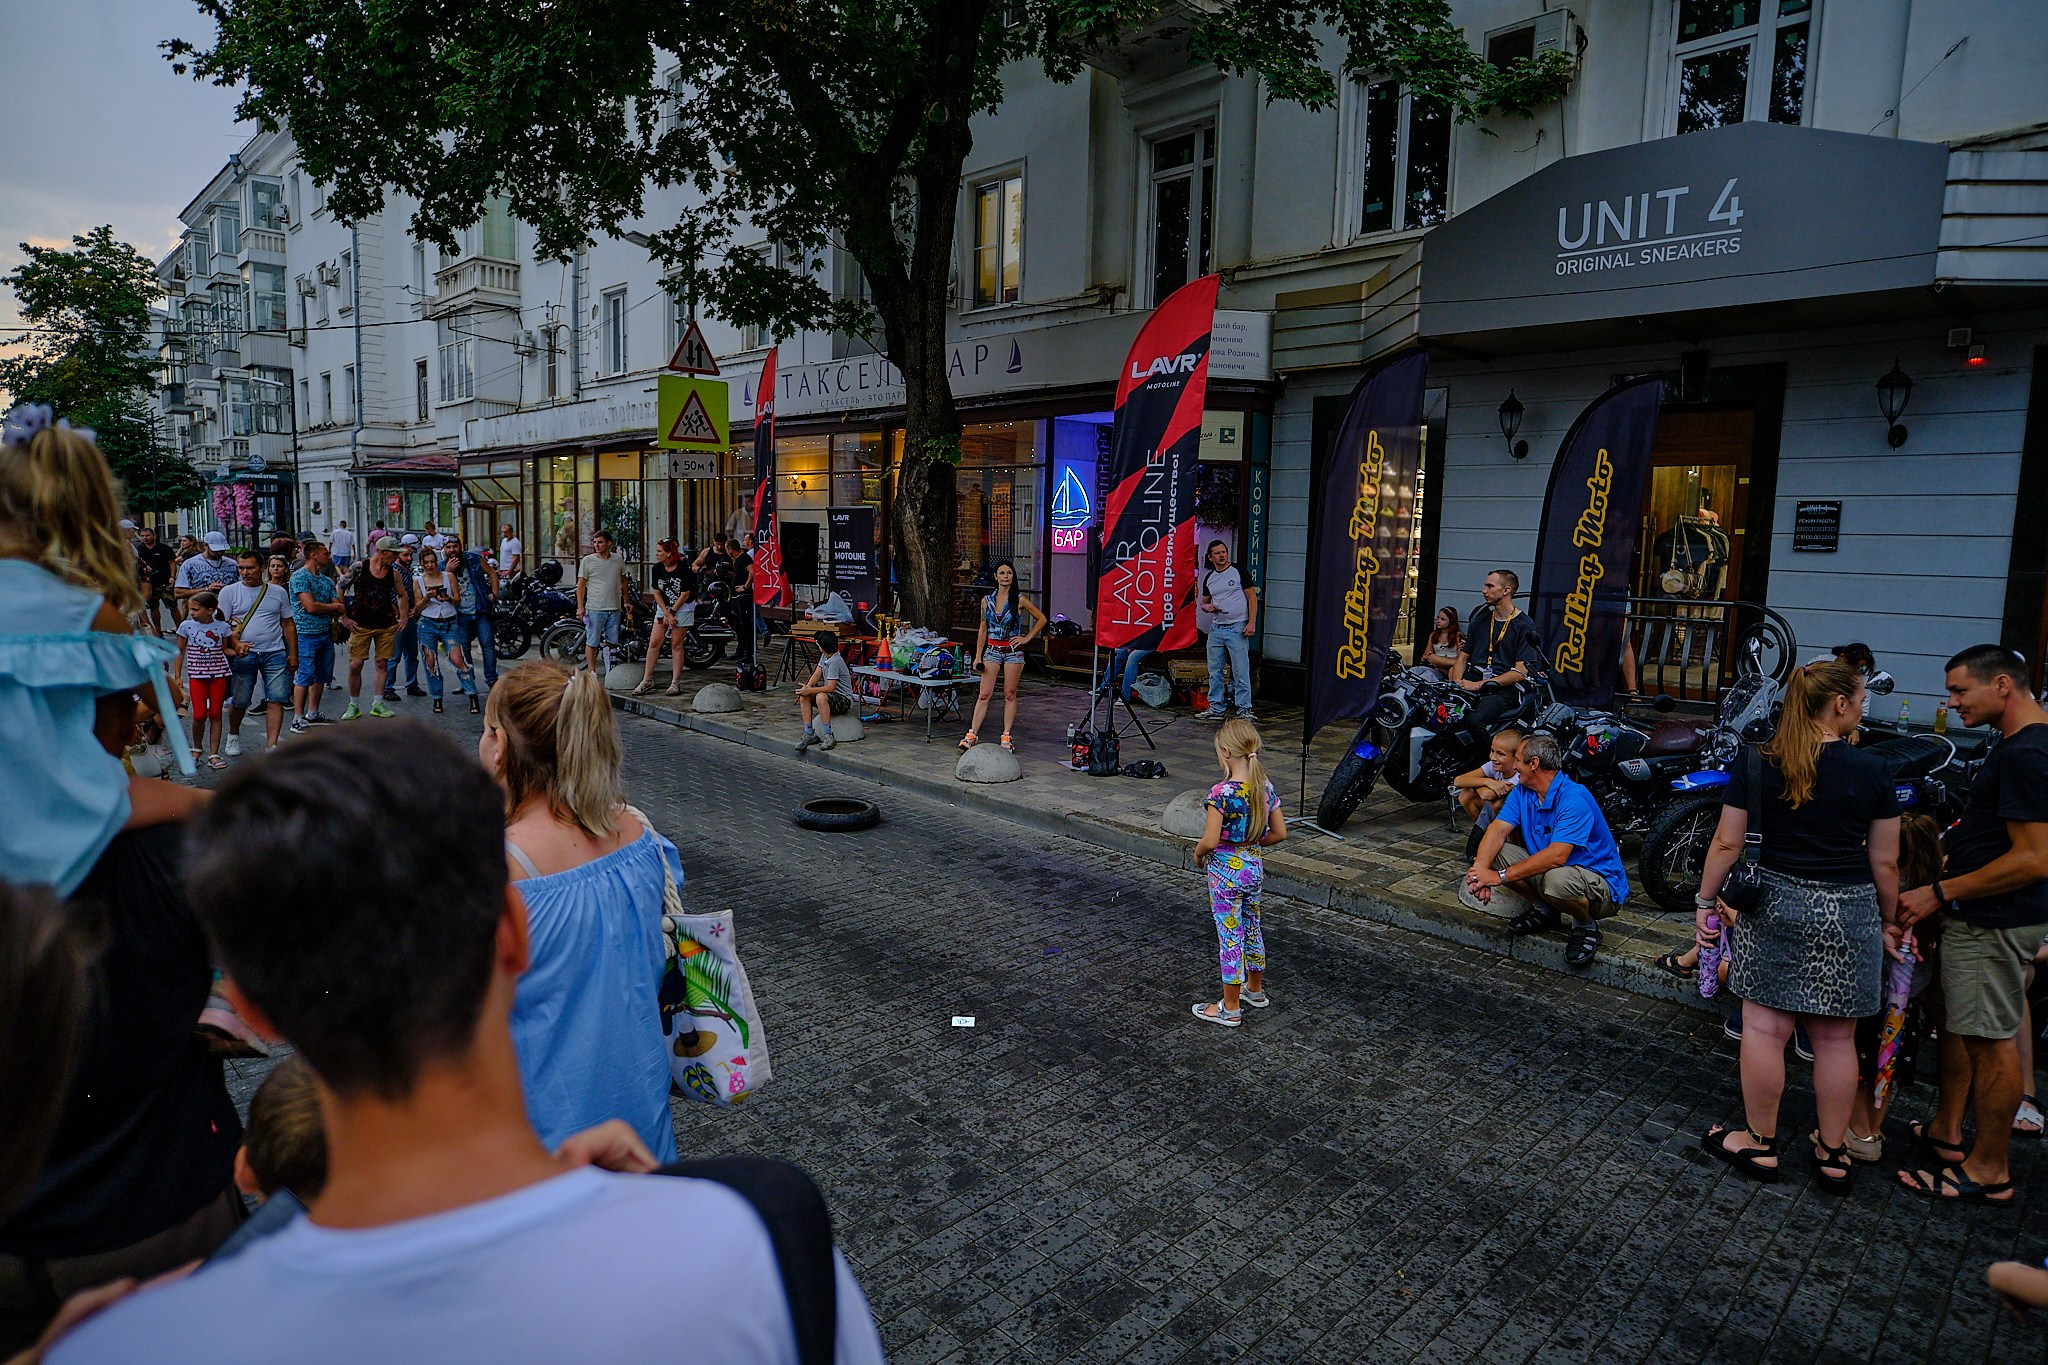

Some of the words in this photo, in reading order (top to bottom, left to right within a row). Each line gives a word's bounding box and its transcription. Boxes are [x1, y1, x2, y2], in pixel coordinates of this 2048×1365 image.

[1557, 186, 1690, 250] UNIT
[1708, 178, 1744, 226] 4
[1555, 251, 1635, 276] ORIGINAL
[1639, 237, 1741, 265] SNEAKERS
[1213, 322, 1230, 330] ший
[781, 358, 906, 399] ТАКСЕЛ
[885, 390, 906, 401] ПАРУ
[1131, 353, 1197, 379] LAVR
[1146, 380, 1181, 391] MOTOLINE
[1349, 429, 1385, 541] Moto
[1572, 448, 1614, 548] Moto
[834, 541, 851, 549] LAVR
[1134, 448, 1166, 627] MOTOLINE
[1163, 453, 1180, 588] преимущество!
[1251, 470, 1262, 582] КОФЕЙНЯ
[758, 529, 772, 588] LAVR
[1112, 540, 1136, 625] LAVR
[1161, 596, 1175, 631] Твое
[1336, 546, 1381, 680] Rolling
[1555, 552, 1605, 674] Rolling
